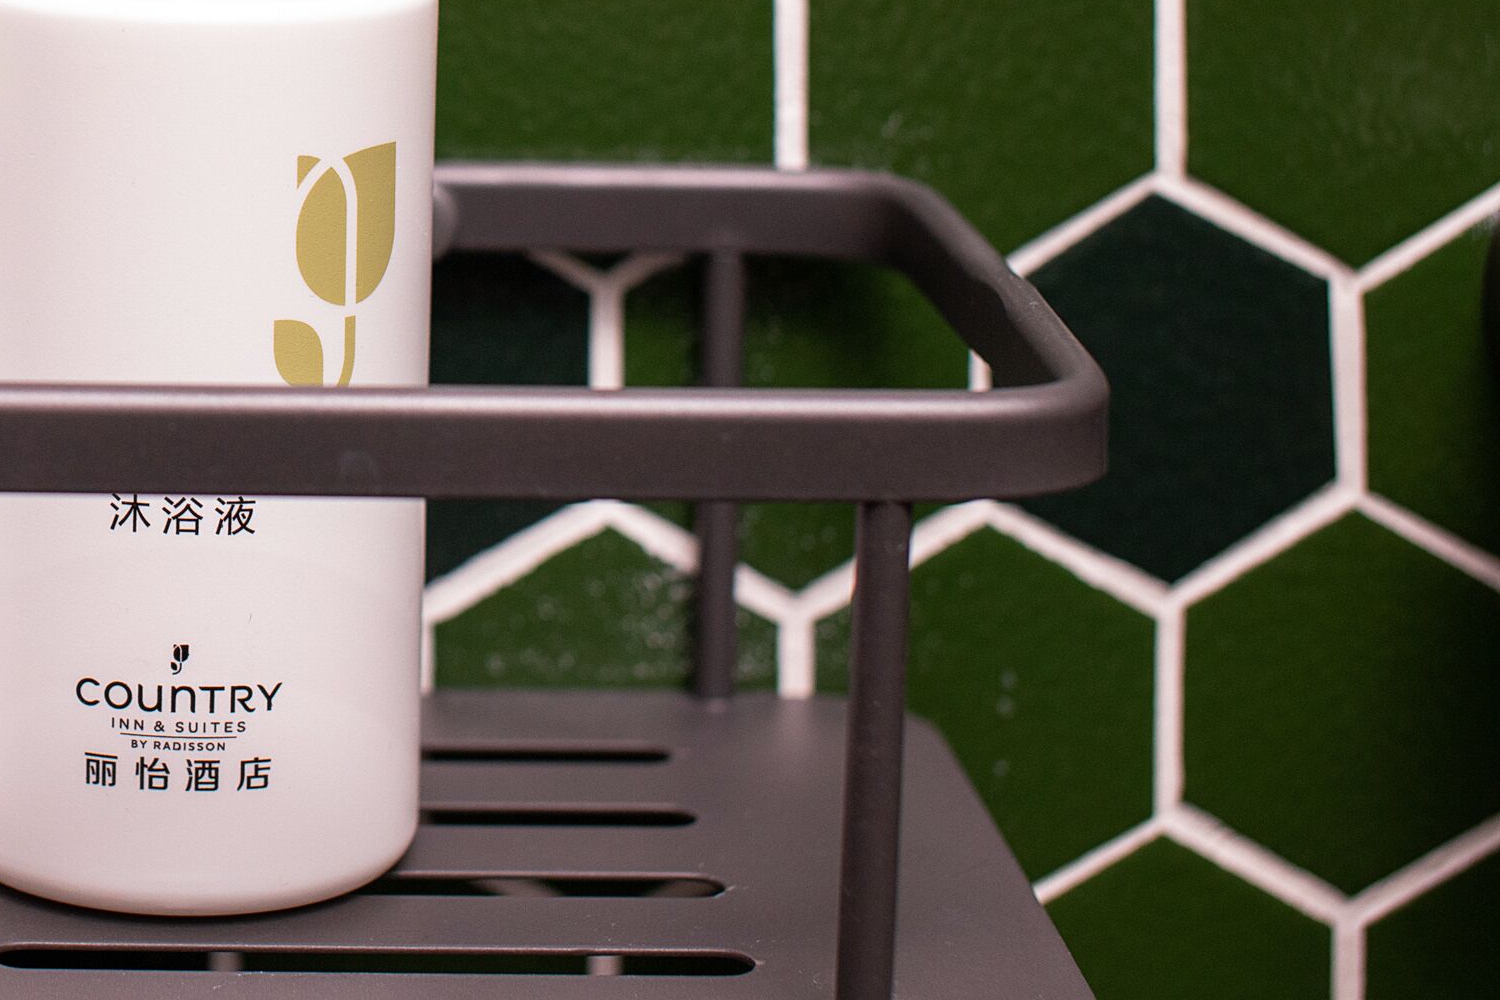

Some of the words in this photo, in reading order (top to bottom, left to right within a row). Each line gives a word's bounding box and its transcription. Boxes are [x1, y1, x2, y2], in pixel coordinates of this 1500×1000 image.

[109, 492, 257, 536] 沐浴液
[110, 716, 145, 731] INN
[153, 720, 165, 733] &
[174, 721, 247, 734] SUITES
[130, 739, 148, 749] BY
[152, 740, 226, 752] RADISSON
[84, 751, 272, 792] 丽怡酒店
